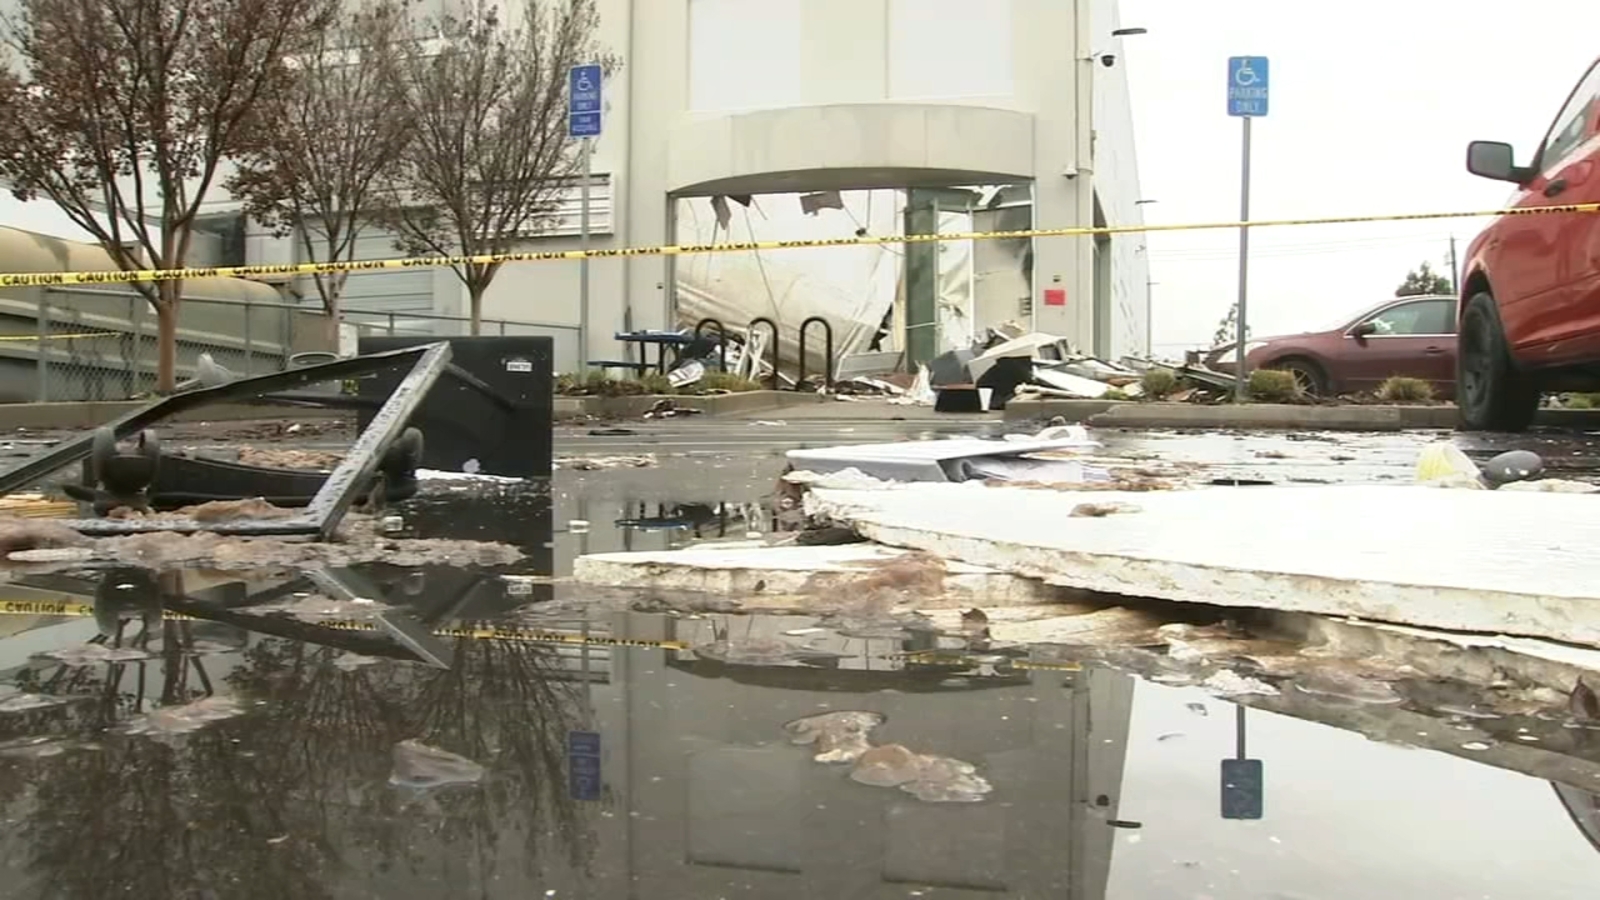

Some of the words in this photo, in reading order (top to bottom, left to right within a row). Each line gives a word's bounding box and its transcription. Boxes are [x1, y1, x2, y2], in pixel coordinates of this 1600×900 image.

[1229, 87, 1267, 99] PARKING
[2, 276, 63, 285] CAUTION
[76, 271, 139, 282] CAUTION
[153, 268, 217, 280] CAUTION
